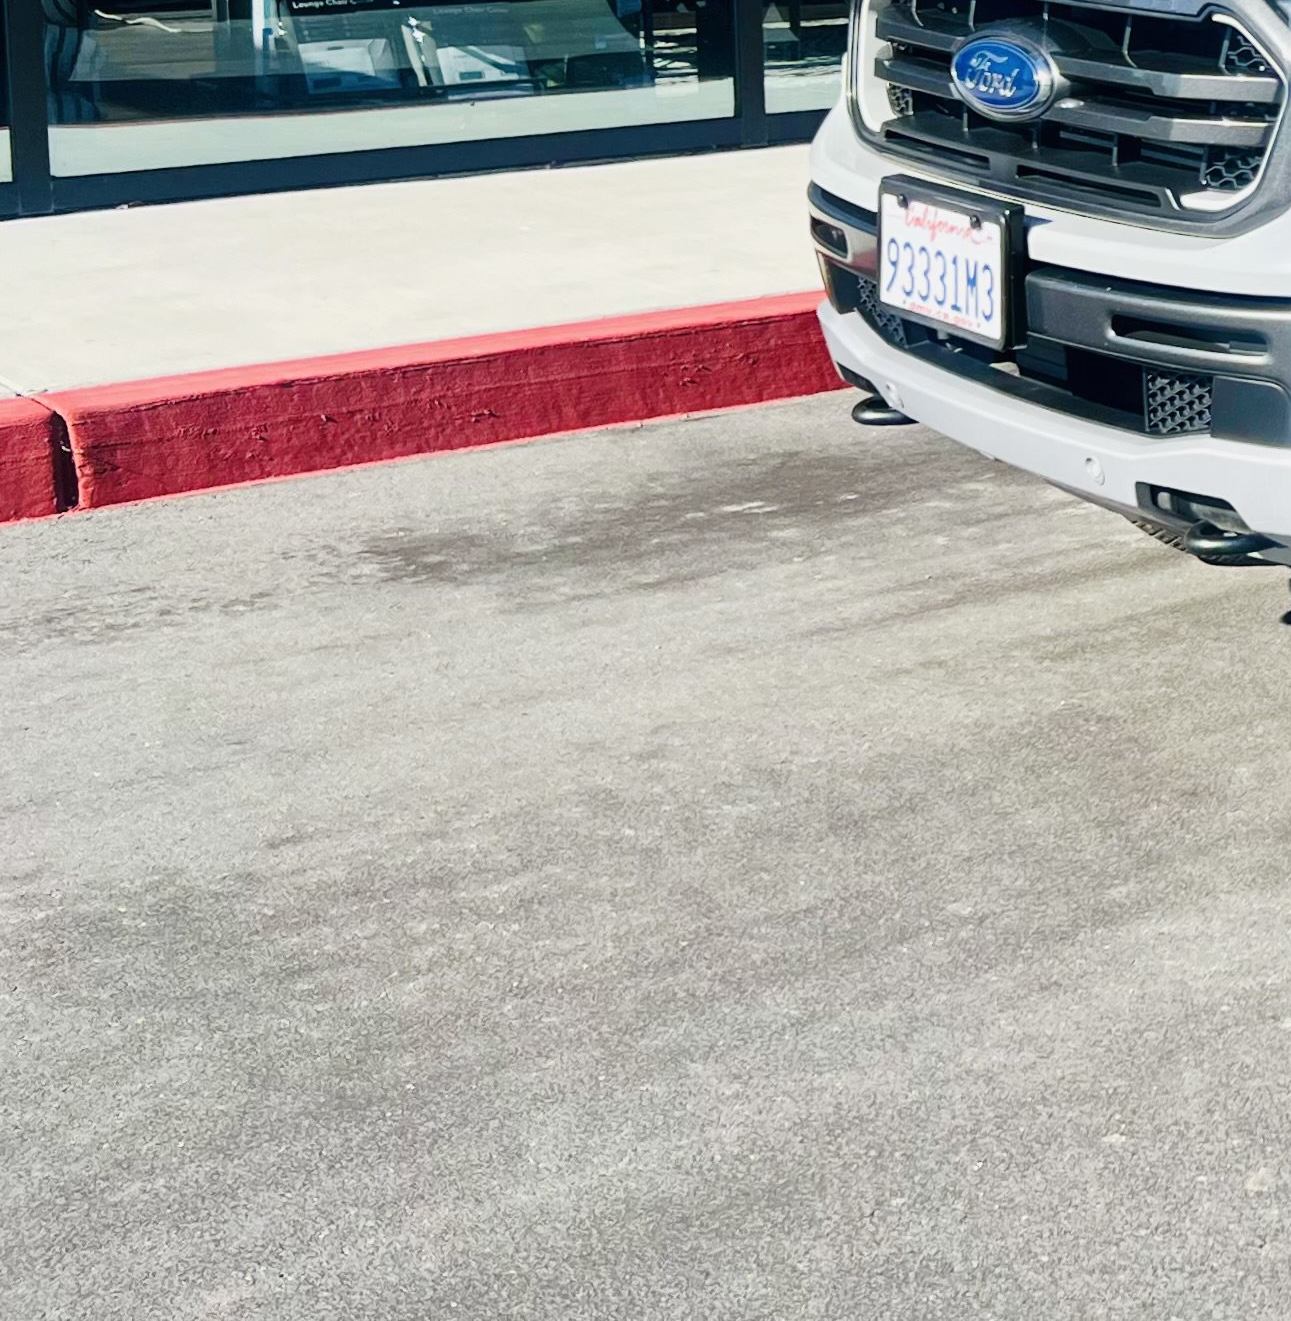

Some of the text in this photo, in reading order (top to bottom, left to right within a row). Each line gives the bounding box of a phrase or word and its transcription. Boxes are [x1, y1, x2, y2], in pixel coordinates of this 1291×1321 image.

[292, 0, 324, 10] Lounge
[965, 50, 1020, 97] Ford
[886, 237, 994, 322] 93331M3
